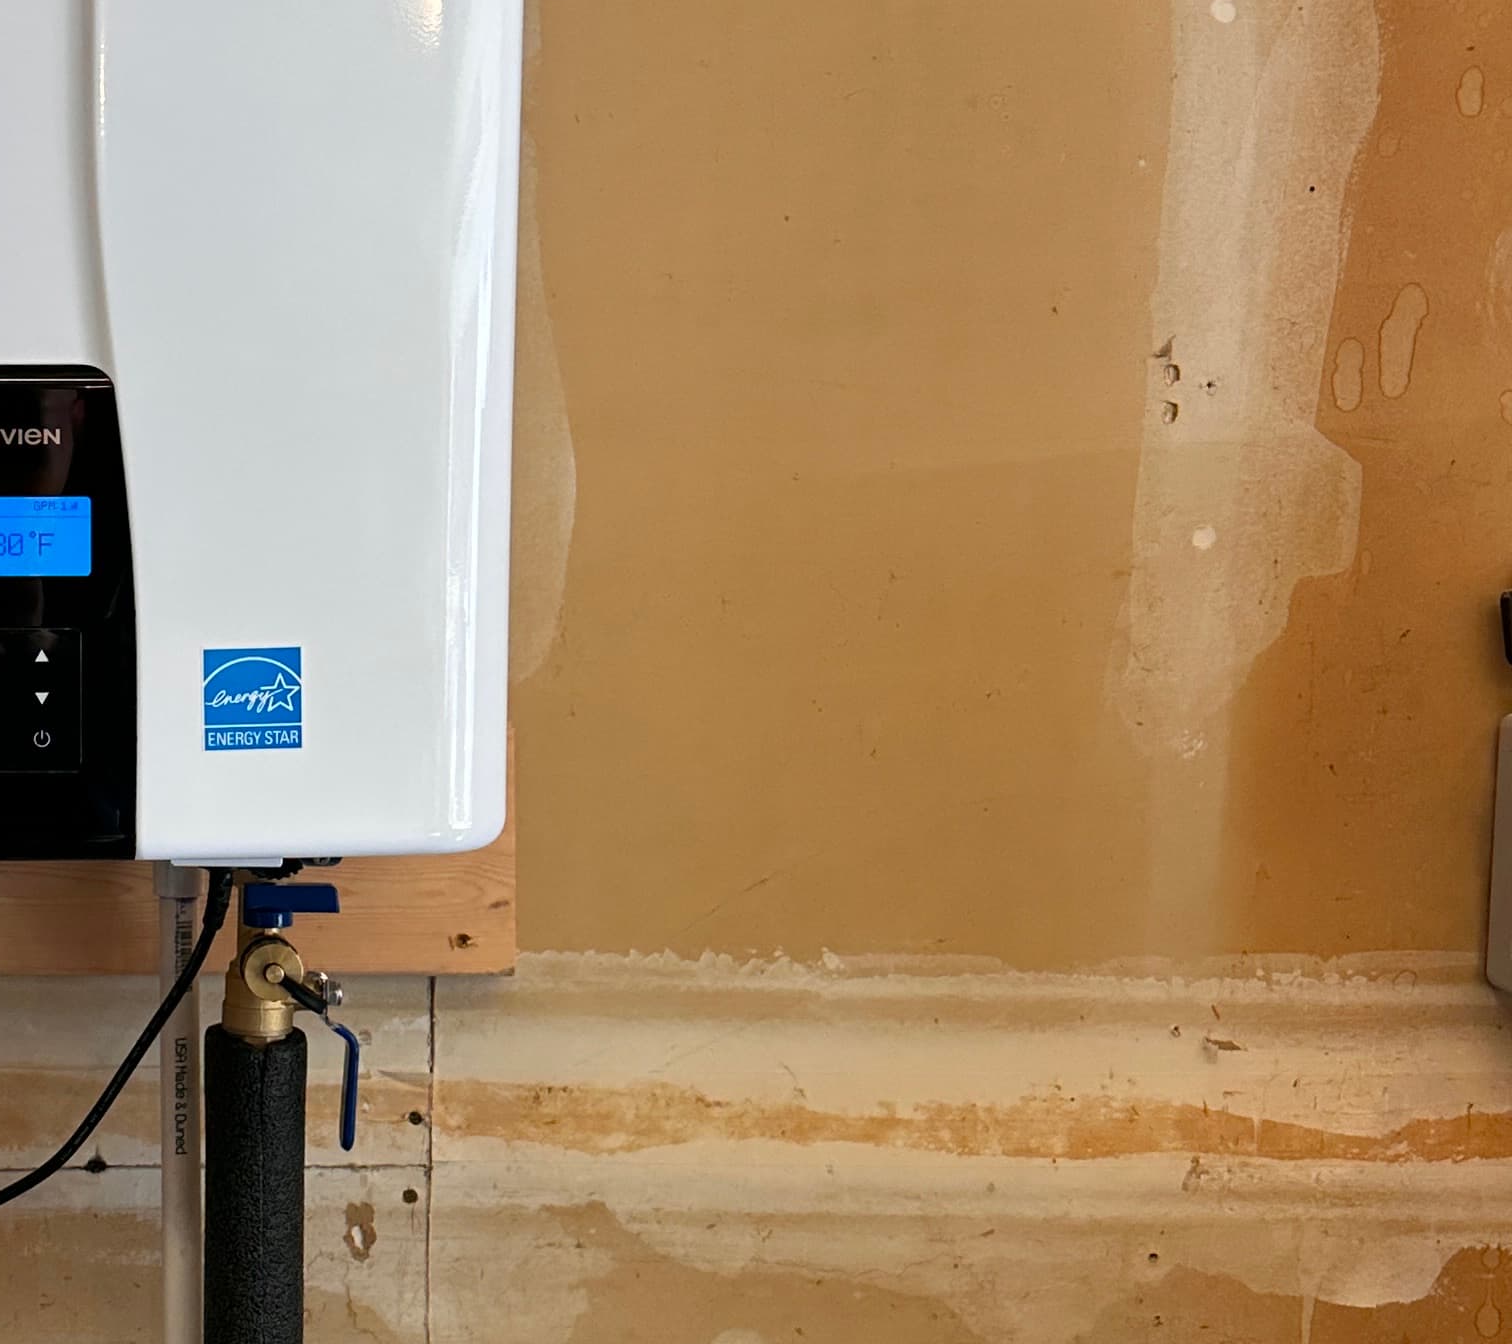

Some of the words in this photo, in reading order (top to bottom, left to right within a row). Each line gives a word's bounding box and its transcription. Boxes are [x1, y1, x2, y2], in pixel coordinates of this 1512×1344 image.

[207, 731, 262, 747] ENERGY
[264, 729, 299, 745] STAR
[174, 1038, 187, 1063] USA
[175, 1065, 188, 1099] Made
